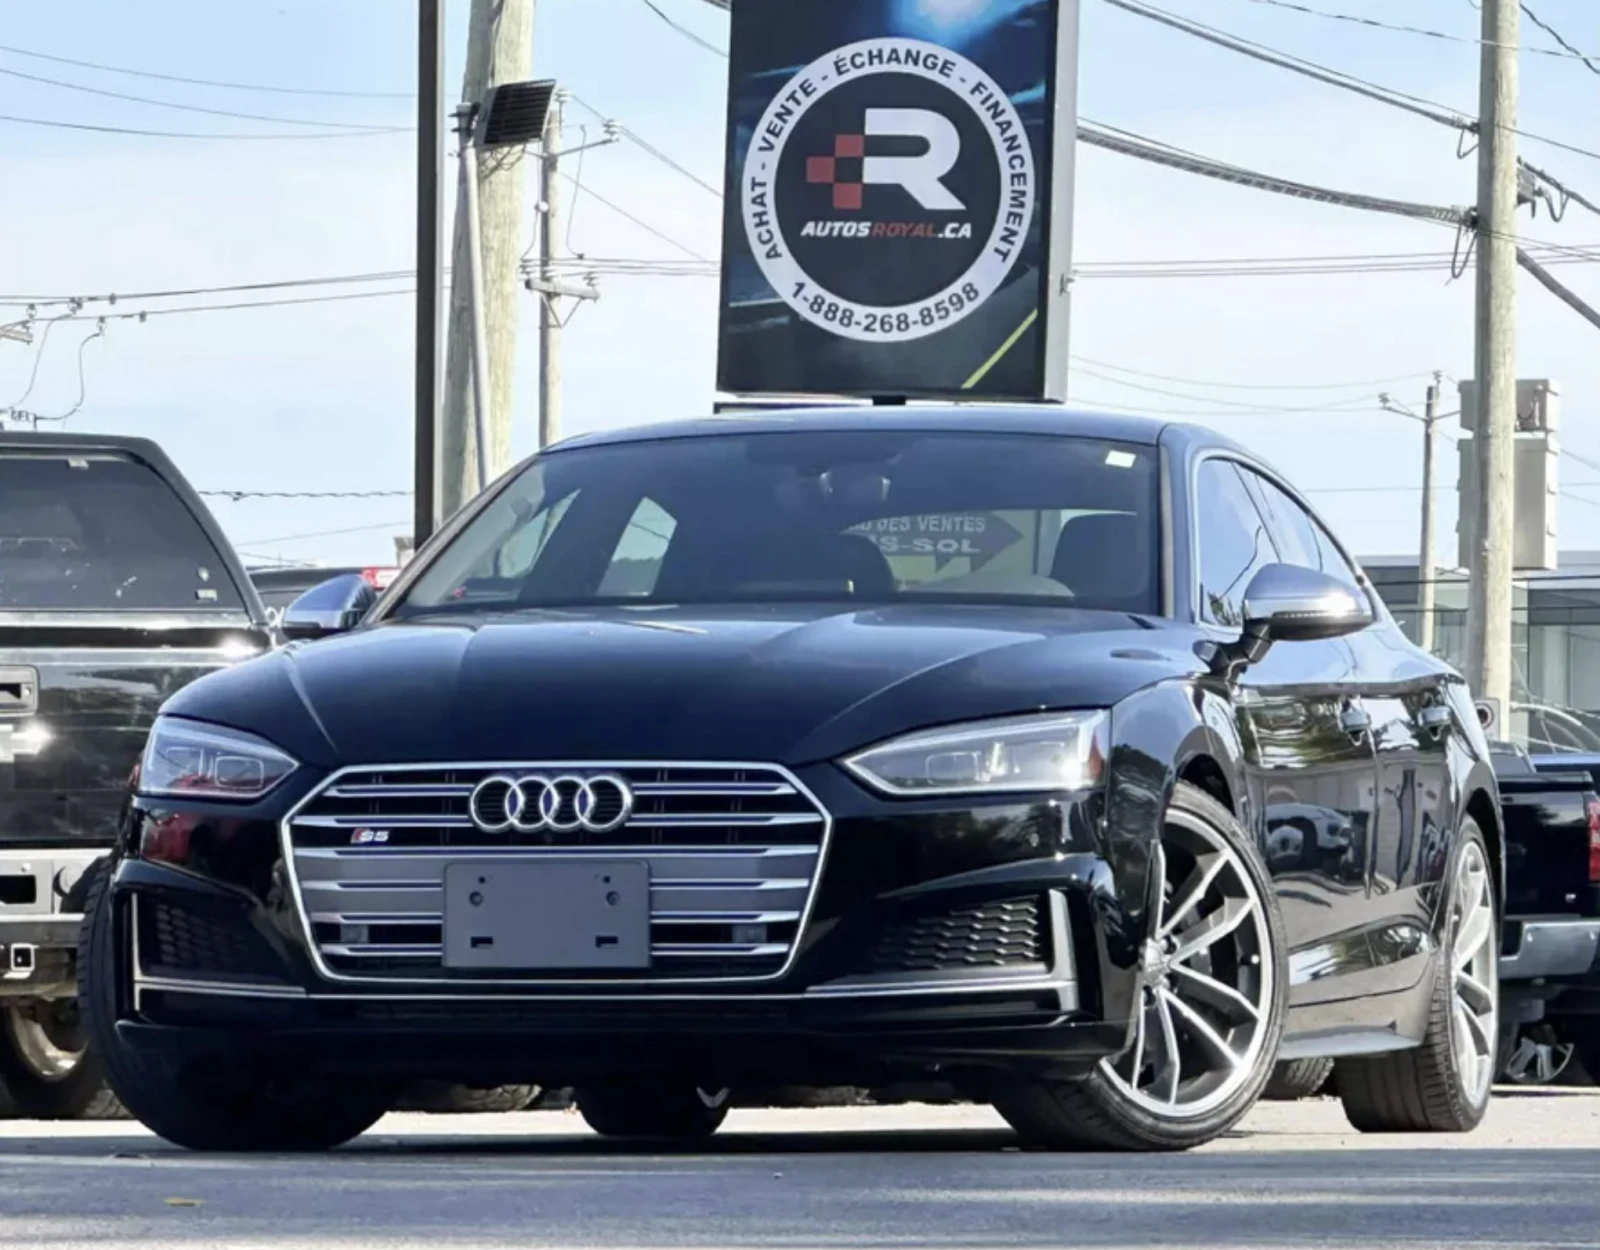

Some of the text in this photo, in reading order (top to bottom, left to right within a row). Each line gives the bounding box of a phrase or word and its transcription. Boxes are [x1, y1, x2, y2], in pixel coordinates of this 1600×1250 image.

[751, 47, 1027, 263] ACHAT VENTE ÉCHANGE FINANCEMENT
[792, 281, 979, 334] 1-888-268-8598
[877, 516, 910, 531] DES
[917, 514, 986, 532] VENTES
[357, 829, 389, 842] S5
